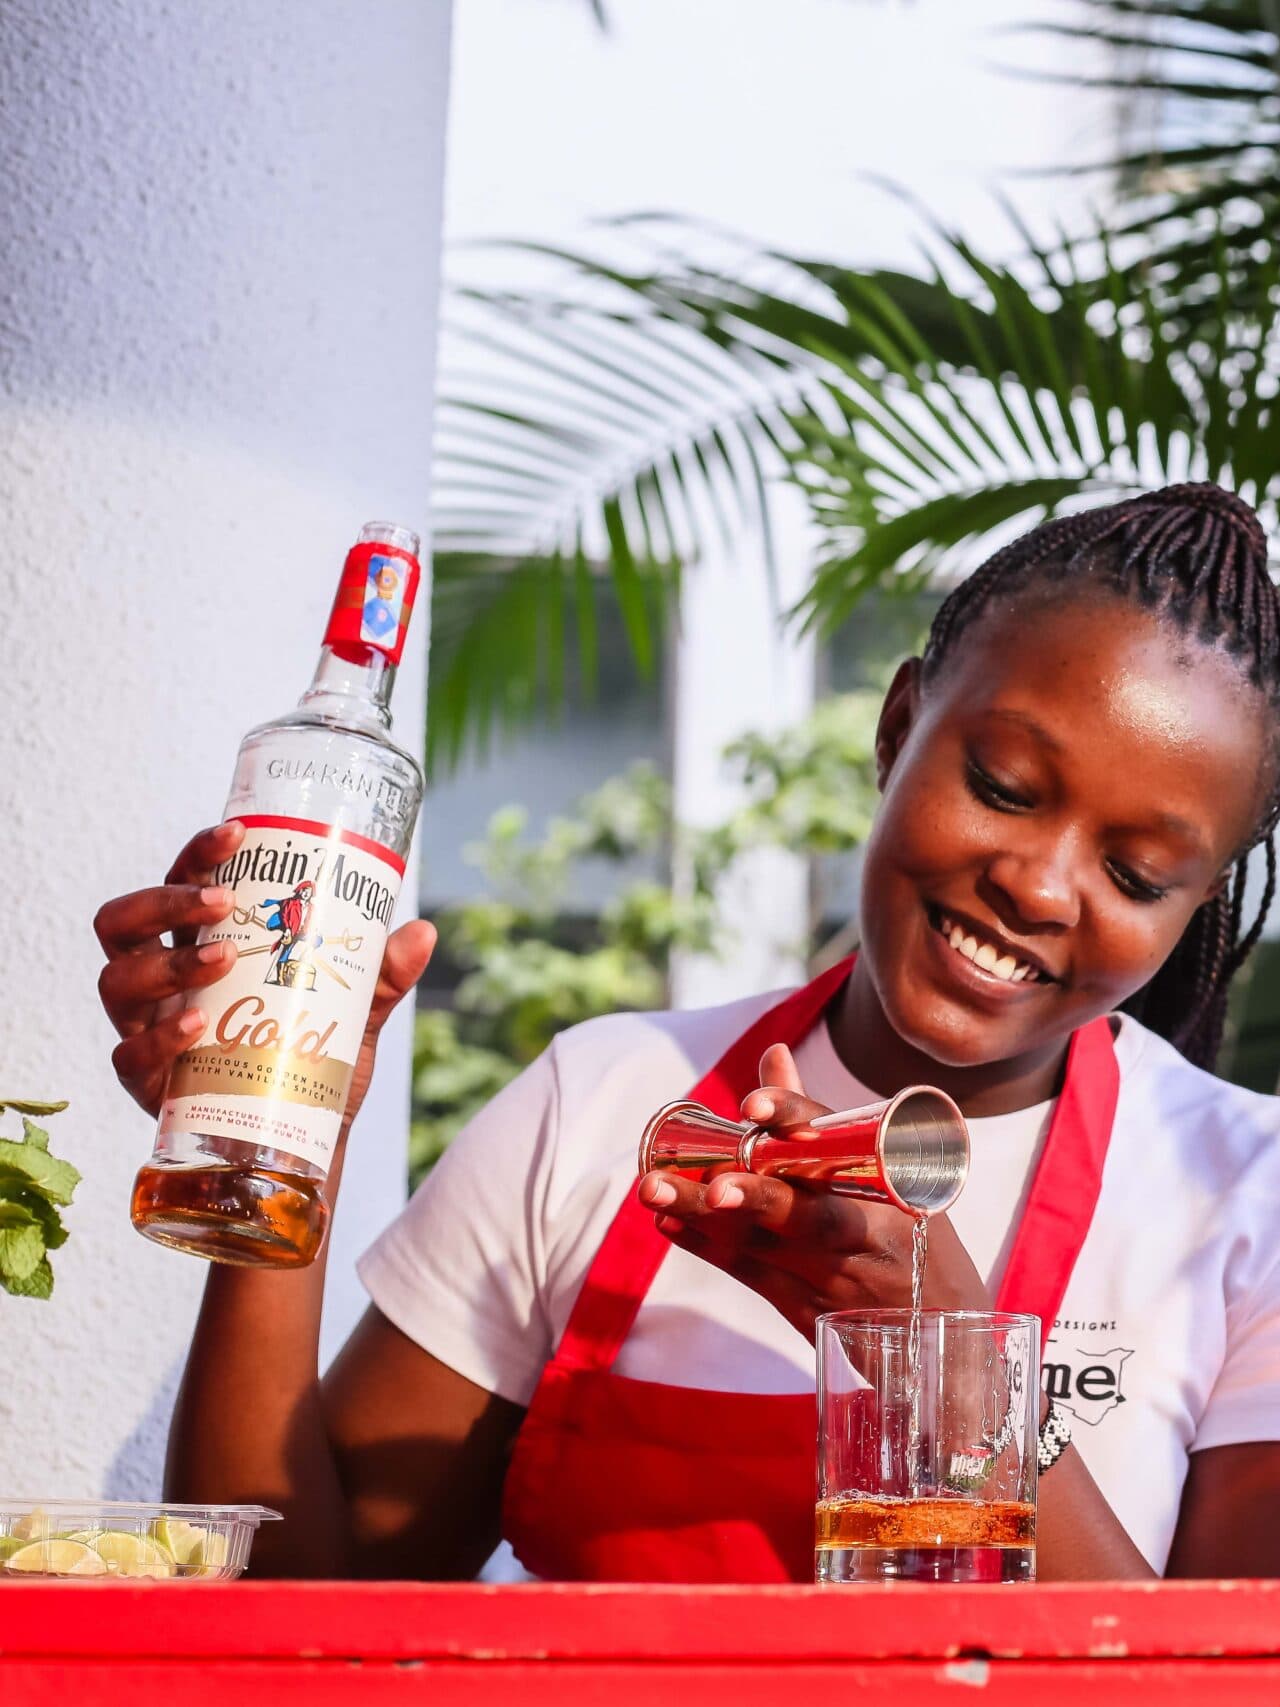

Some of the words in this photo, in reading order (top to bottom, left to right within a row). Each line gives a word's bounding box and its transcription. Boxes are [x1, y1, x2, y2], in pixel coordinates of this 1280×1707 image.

[192, 1065, 221, 1075] WITH
[293, 1084, 325, 1102] SPICE
[256, 1064, 307, 1084] GODEN
